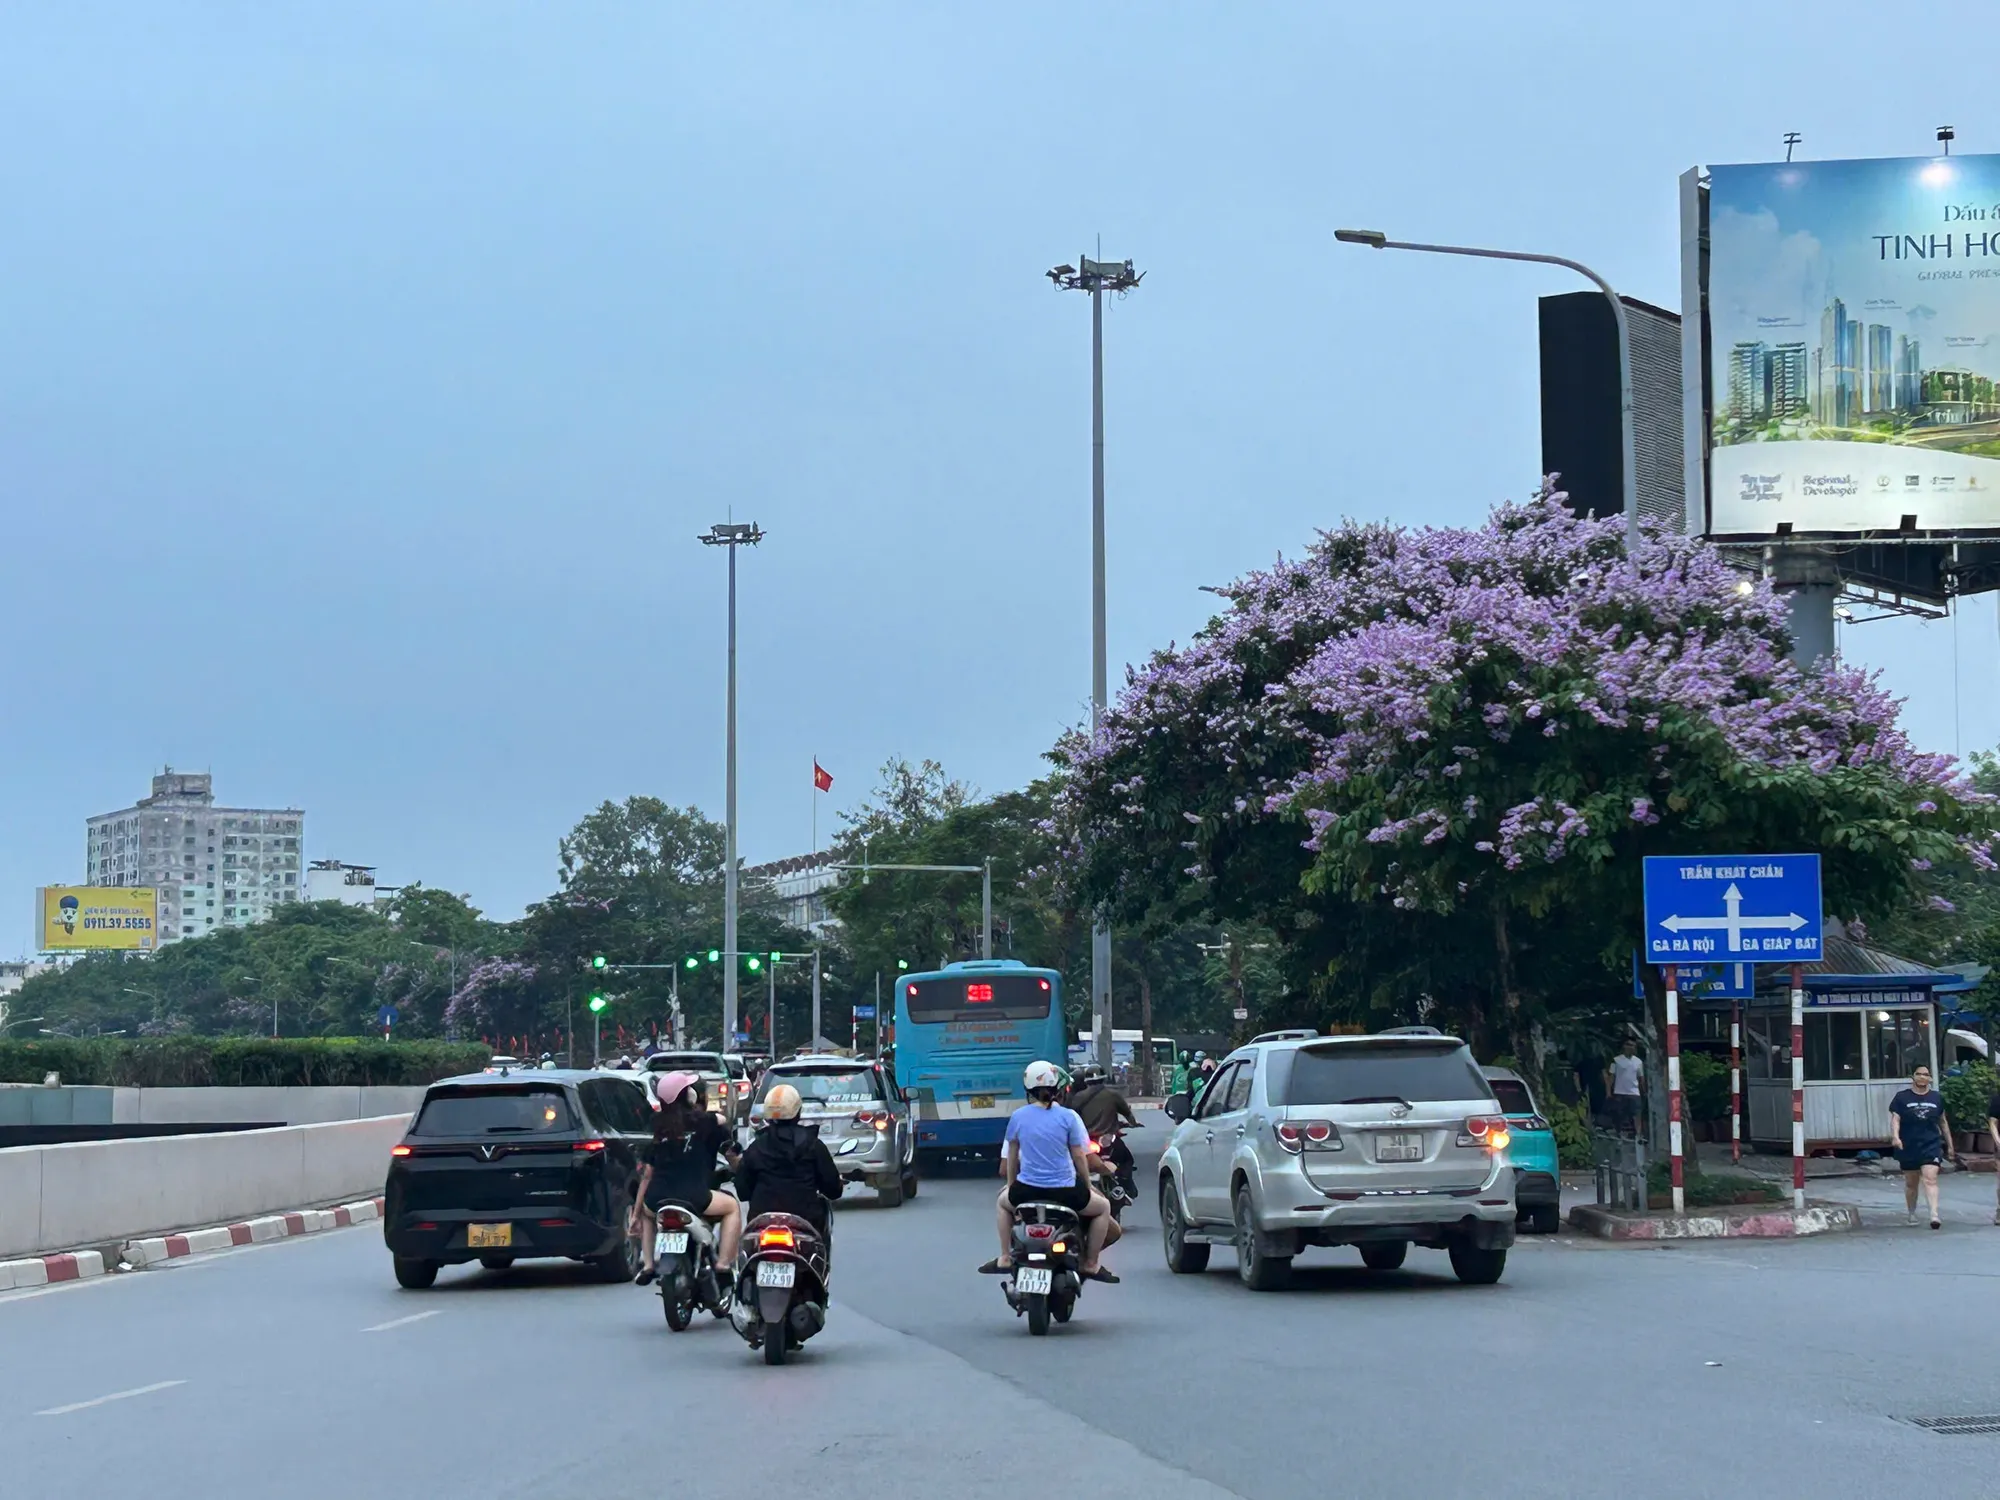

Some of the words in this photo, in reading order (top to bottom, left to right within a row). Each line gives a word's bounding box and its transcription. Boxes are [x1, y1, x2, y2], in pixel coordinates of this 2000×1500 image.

[1944, 203, 1986, 221] Dấu
[1872, 234, 1952, 260] TINH
[1653, 940, 1670, 951] GA
[1743, 939, 1760, 951] GA
